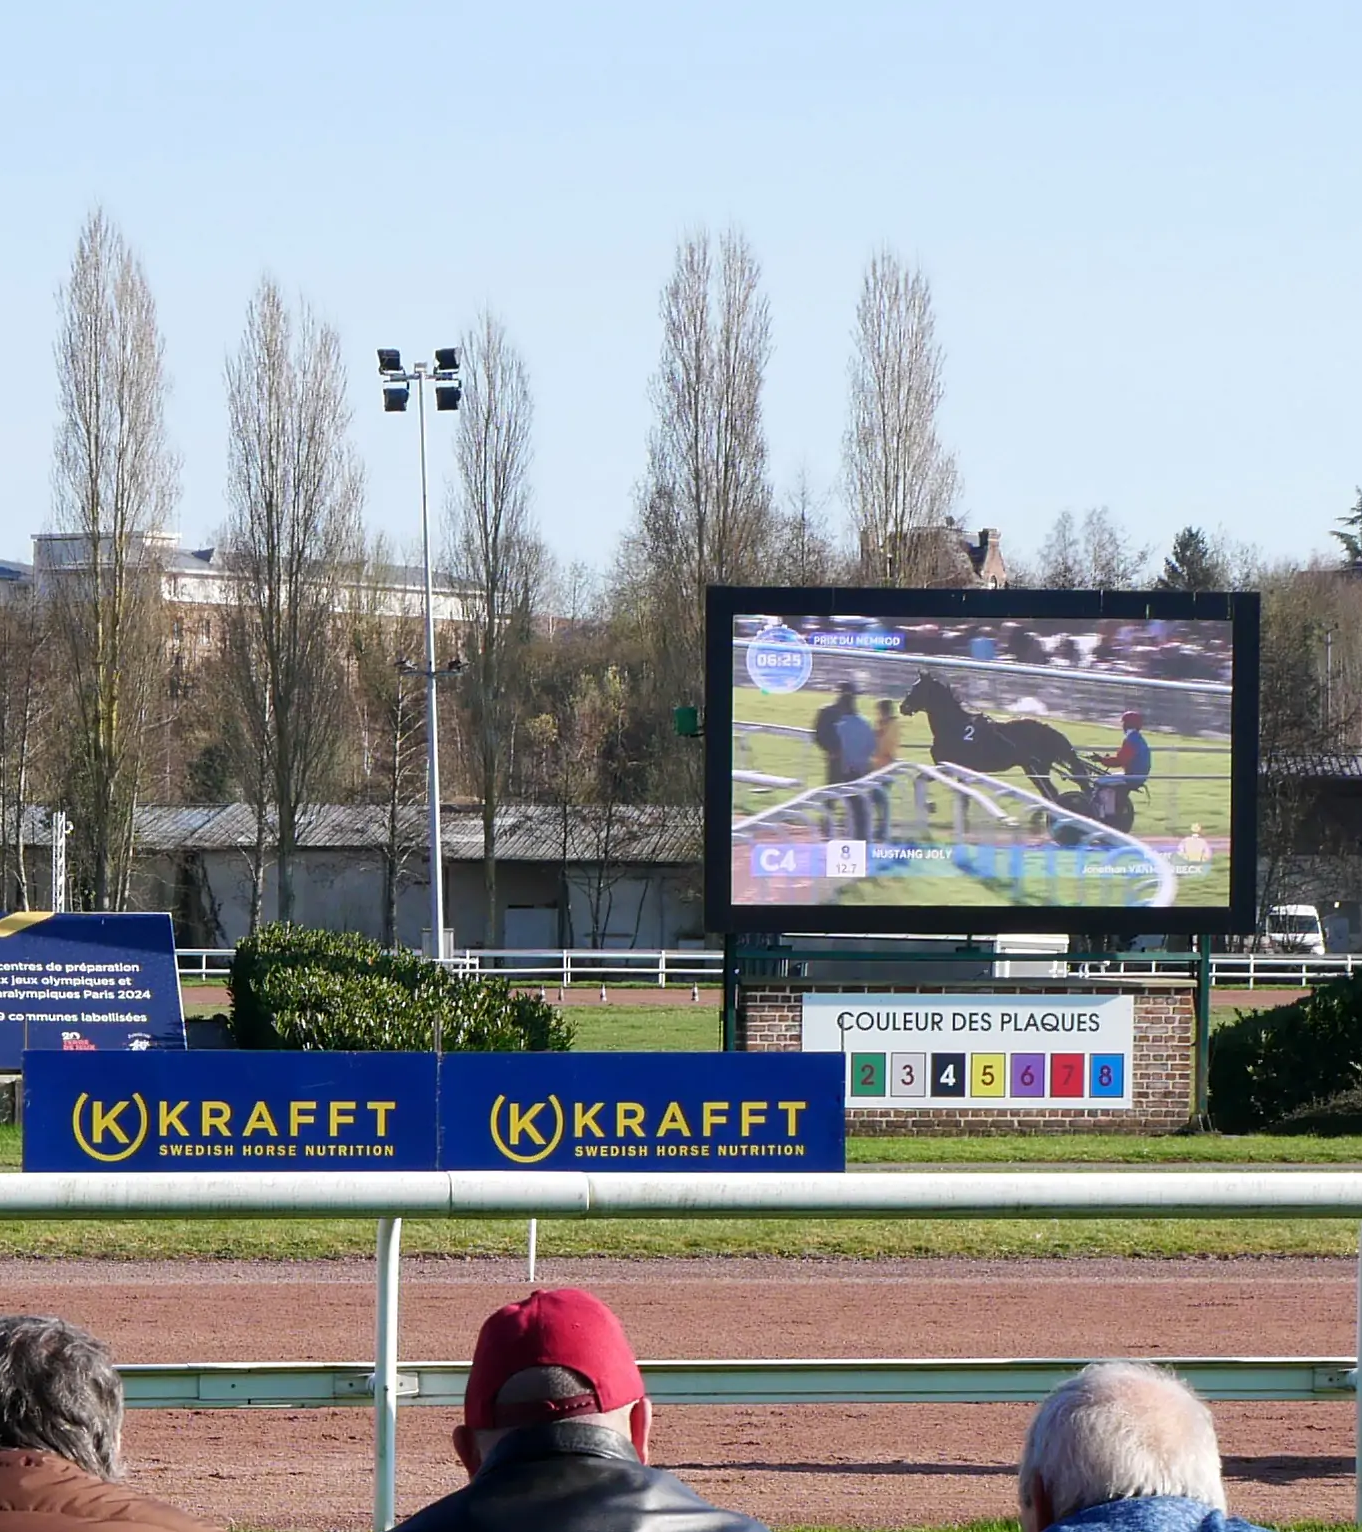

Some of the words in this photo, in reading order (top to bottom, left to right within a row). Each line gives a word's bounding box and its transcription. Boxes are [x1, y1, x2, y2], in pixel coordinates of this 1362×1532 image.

[814, 635, 837, 646] PRIX
[839, 636, 853, 646] DU
[855, 636, 900, 646] NEMROD
[757, 654, 801, 667] 06:25
[963, 725, 975, 740] 2
[759, 848, 797, 872] C4
[926, 849, 952, 860] JOLY
[1082, 864, 1126, 875] Jonathan
[46, 962, 62, 972] de
[65, 962, 140, 973] préparation
[11, 975, 38, 986] jeux
[41, 975, 116, 987] olympiques
[118, 977, 132, 986] et
[83, 989, 115, 1000] Paris
[117, 989, 152, 1000] 2024
[8, 1012, 78, 1022] communes
[81, 1012, 148, 1022] labellisées
[837, 1011, 944, 1032] COULEUR
[952, 1012, 992, 1032] DES
[1000, 1012, 1101, 1033] PLAQUES
[860, 1065, 876, 1086] 2
[900, 1065, 915, 1086] 3
[939, 1064, 957, 1086] 4
[980, 1065, 995, 1086] 5
[1020, 1065, 1035, 1086] 6
[1061, 1065, 1075, 1086] 7
[1098, 1065, 1113, 1087] 8
[158, 1100, 397, 1137] KRAFFT
[573, 1101, 807, 1138] KRAFFT
[158, 1144, 235, 1156] SWEDISH
[242, 1144, 297, 1157] HORSE
[305, 1144, 395, 1157] NUTRITION
[574, 1145, 649, 1157] SWEDISH
[655, 1145, 711, 1157] HORSE
[717, 1144, 806, 1157] NUTRITION
